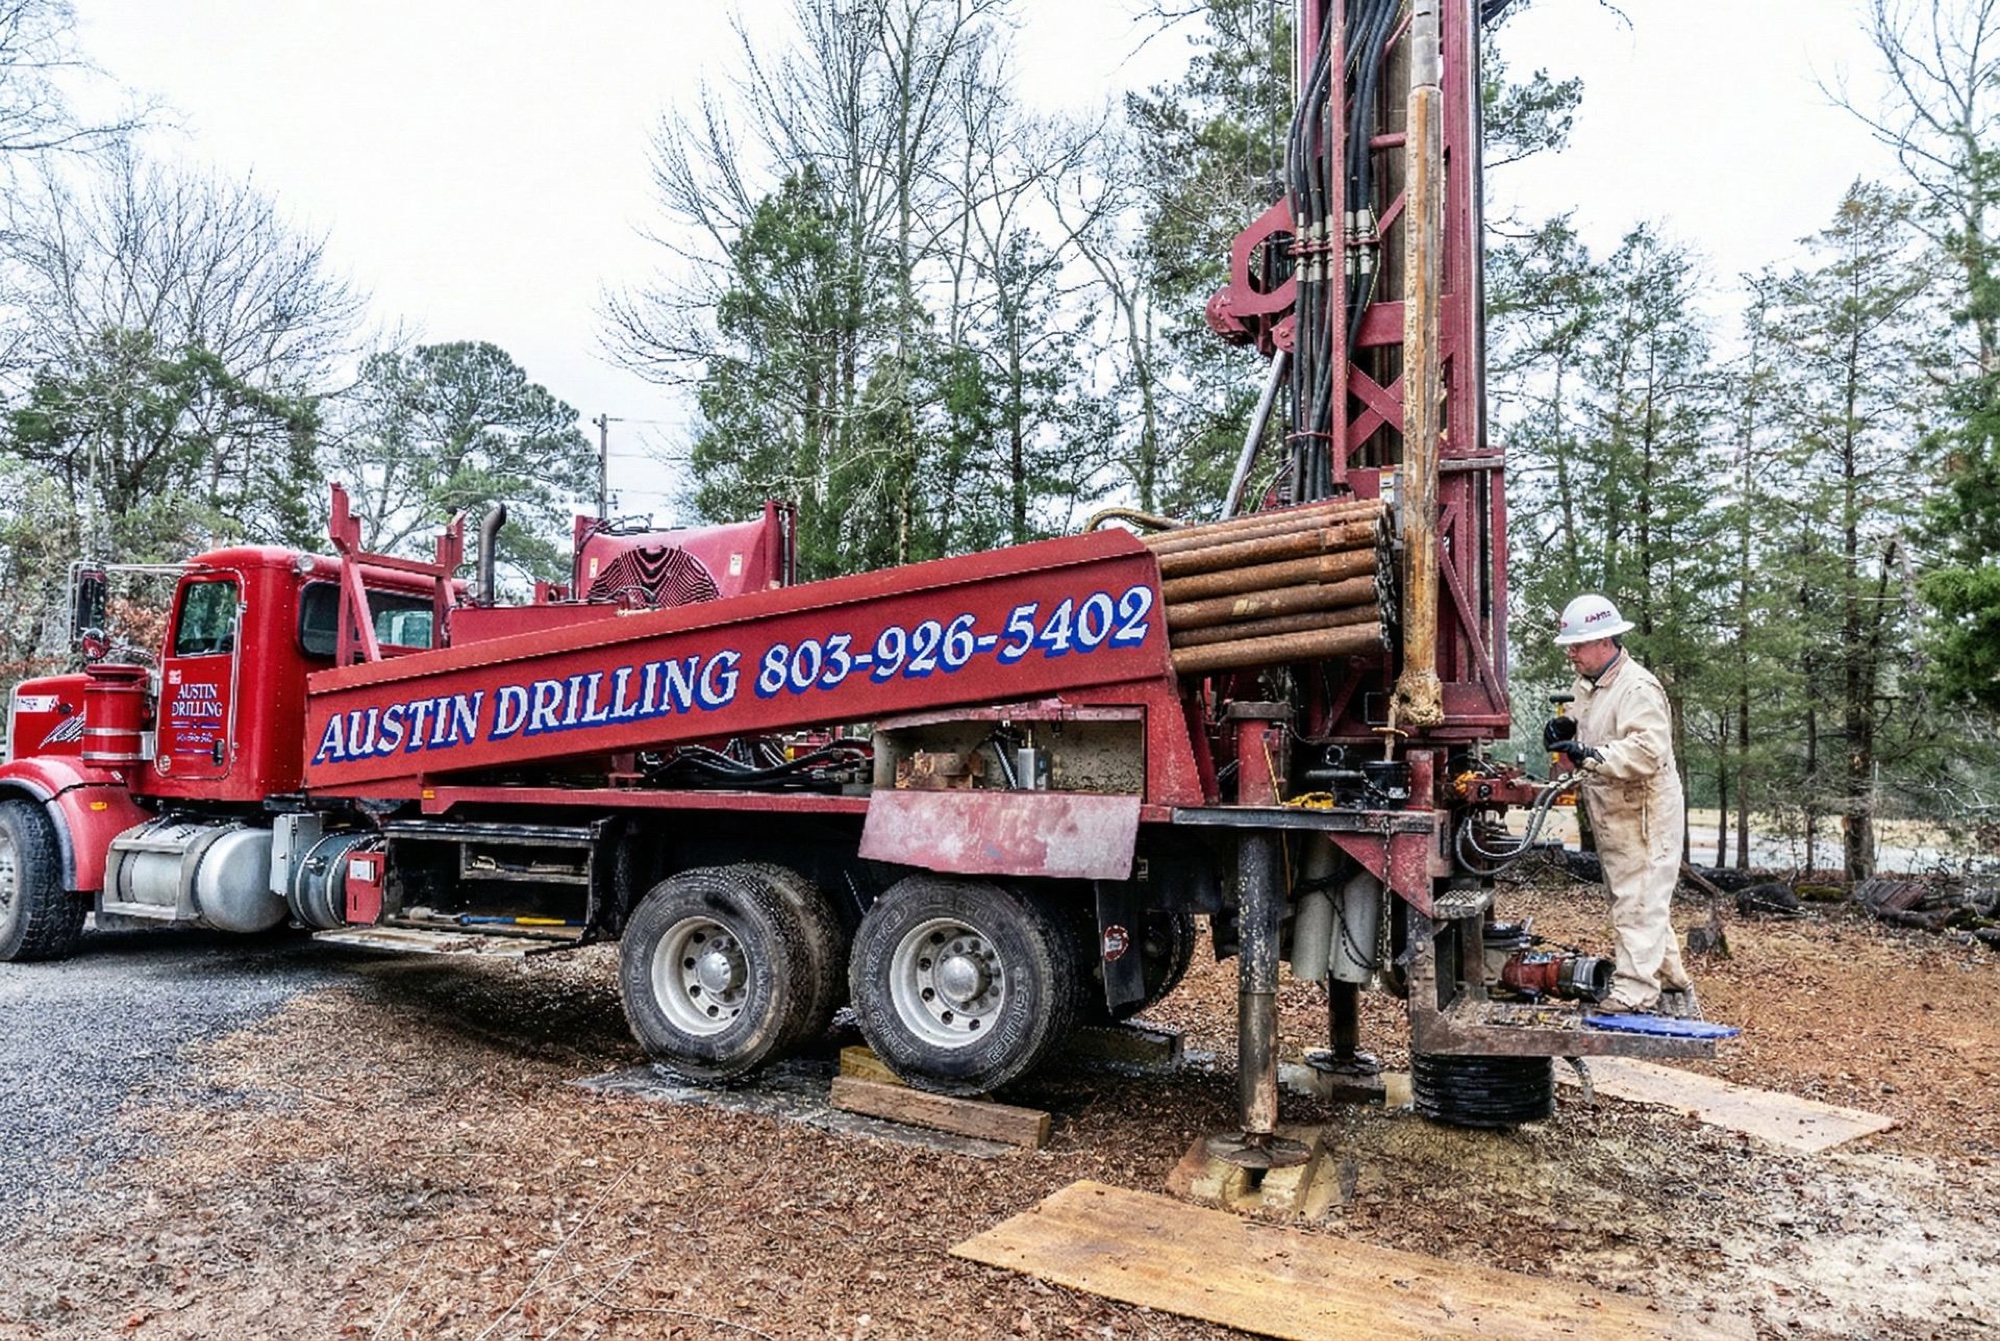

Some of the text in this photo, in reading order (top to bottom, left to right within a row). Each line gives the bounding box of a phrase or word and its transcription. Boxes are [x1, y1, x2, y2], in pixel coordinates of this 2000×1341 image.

[311, 585, 1154, 764] AUSTIN DRILLING 803-926-5402
[177, 683, 218, 699] AUSTIN
[171, 701, 223, 717] DRILLING
